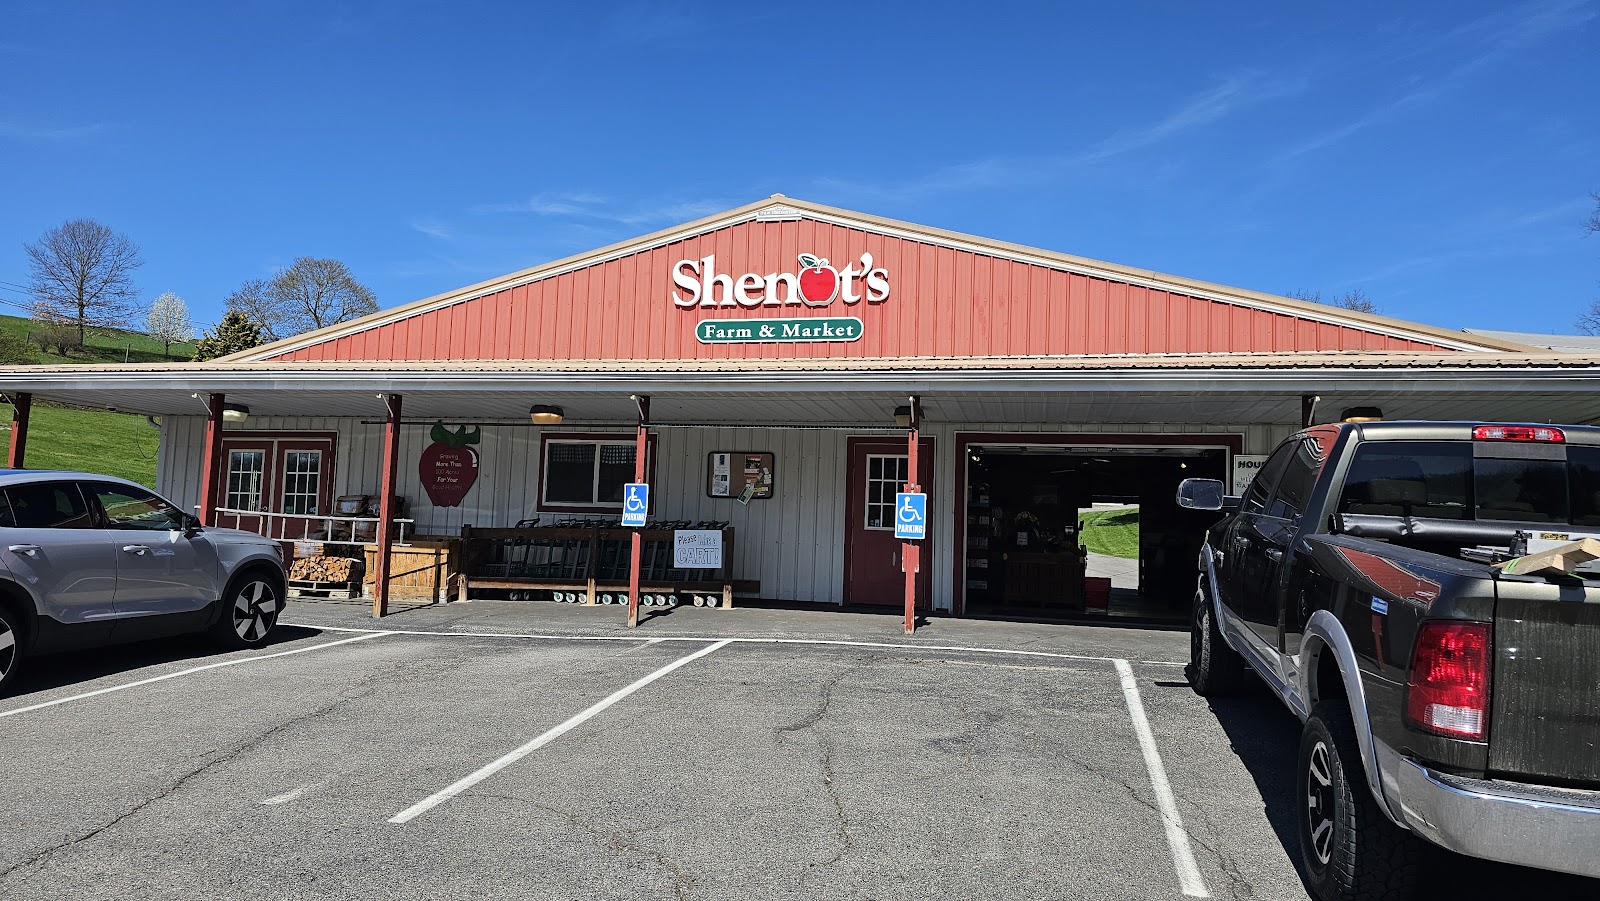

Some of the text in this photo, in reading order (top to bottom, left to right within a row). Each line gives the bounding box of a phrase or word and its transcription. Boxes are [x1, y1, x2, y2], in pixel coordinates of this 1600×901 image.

[704, 322, 854, 338] Farm & Market
[624, 512, 646, 522] PARKING
[897, 523, 924, 534] PARKING
[677, 534, 697, 545] Please
[676, 547, 719, 565] CART!
